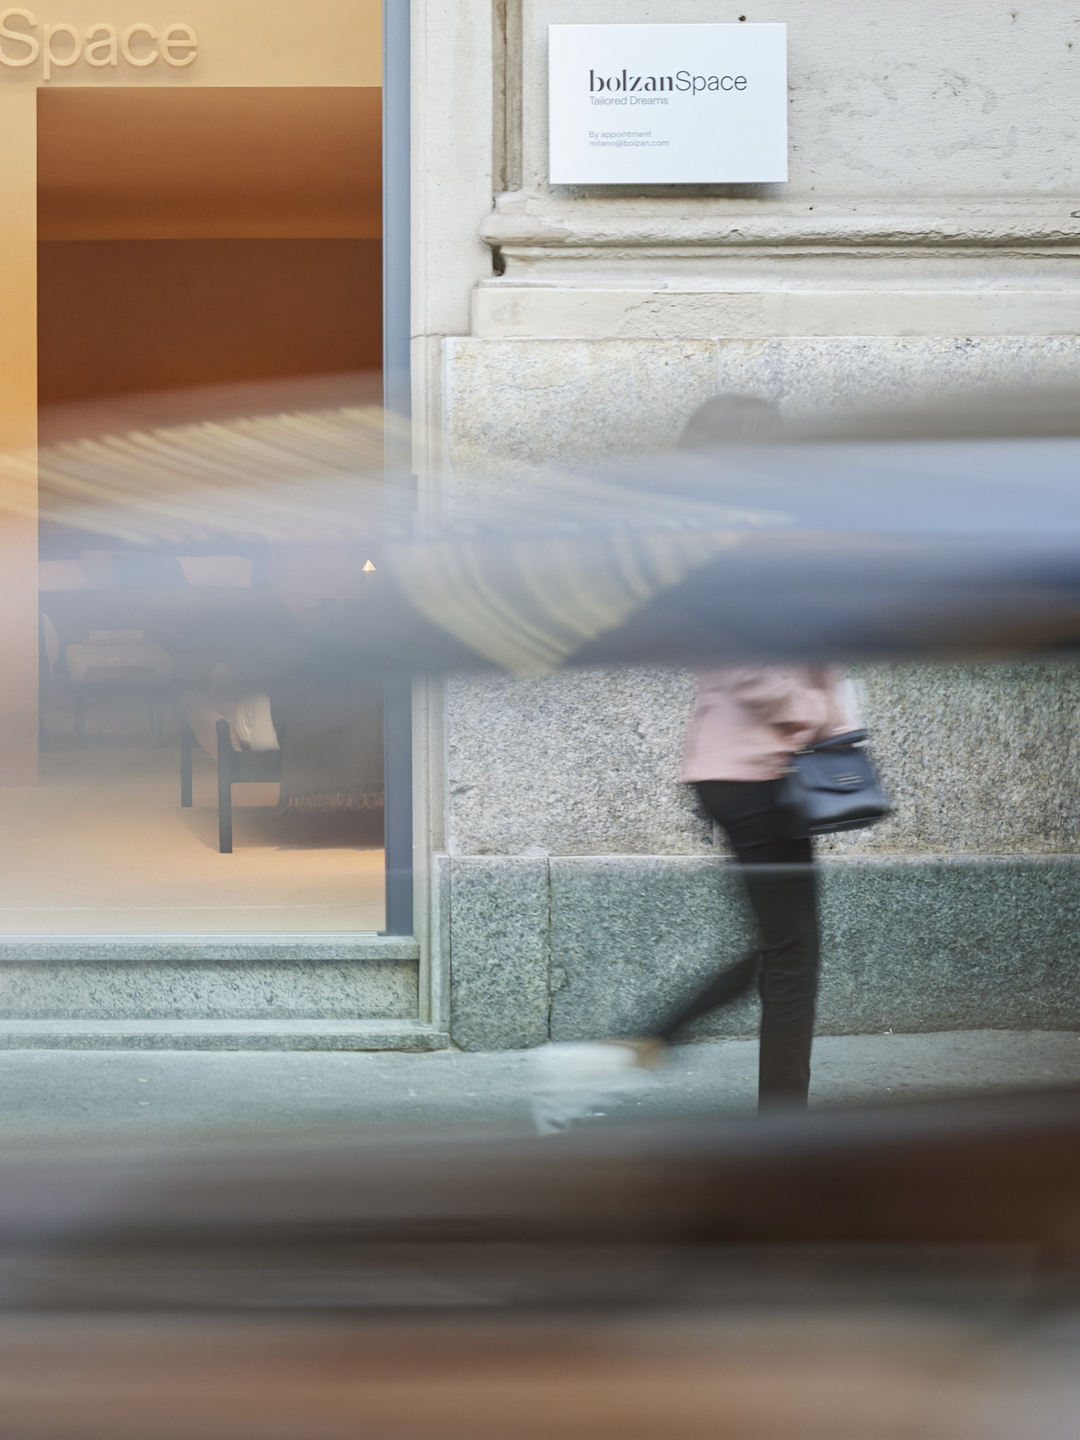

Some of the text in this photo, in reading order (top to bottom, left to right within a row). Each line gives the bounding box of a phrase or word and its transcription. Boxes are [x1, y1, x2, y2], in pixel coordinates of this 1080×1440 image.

[589, 69, 747, 95] bolzanSpace
[589, 95, 669, 105] Tailored Dreams
[589, 131, 652, 139] By appointment
[589, 140, 669, 148] milano@bolzan.com
